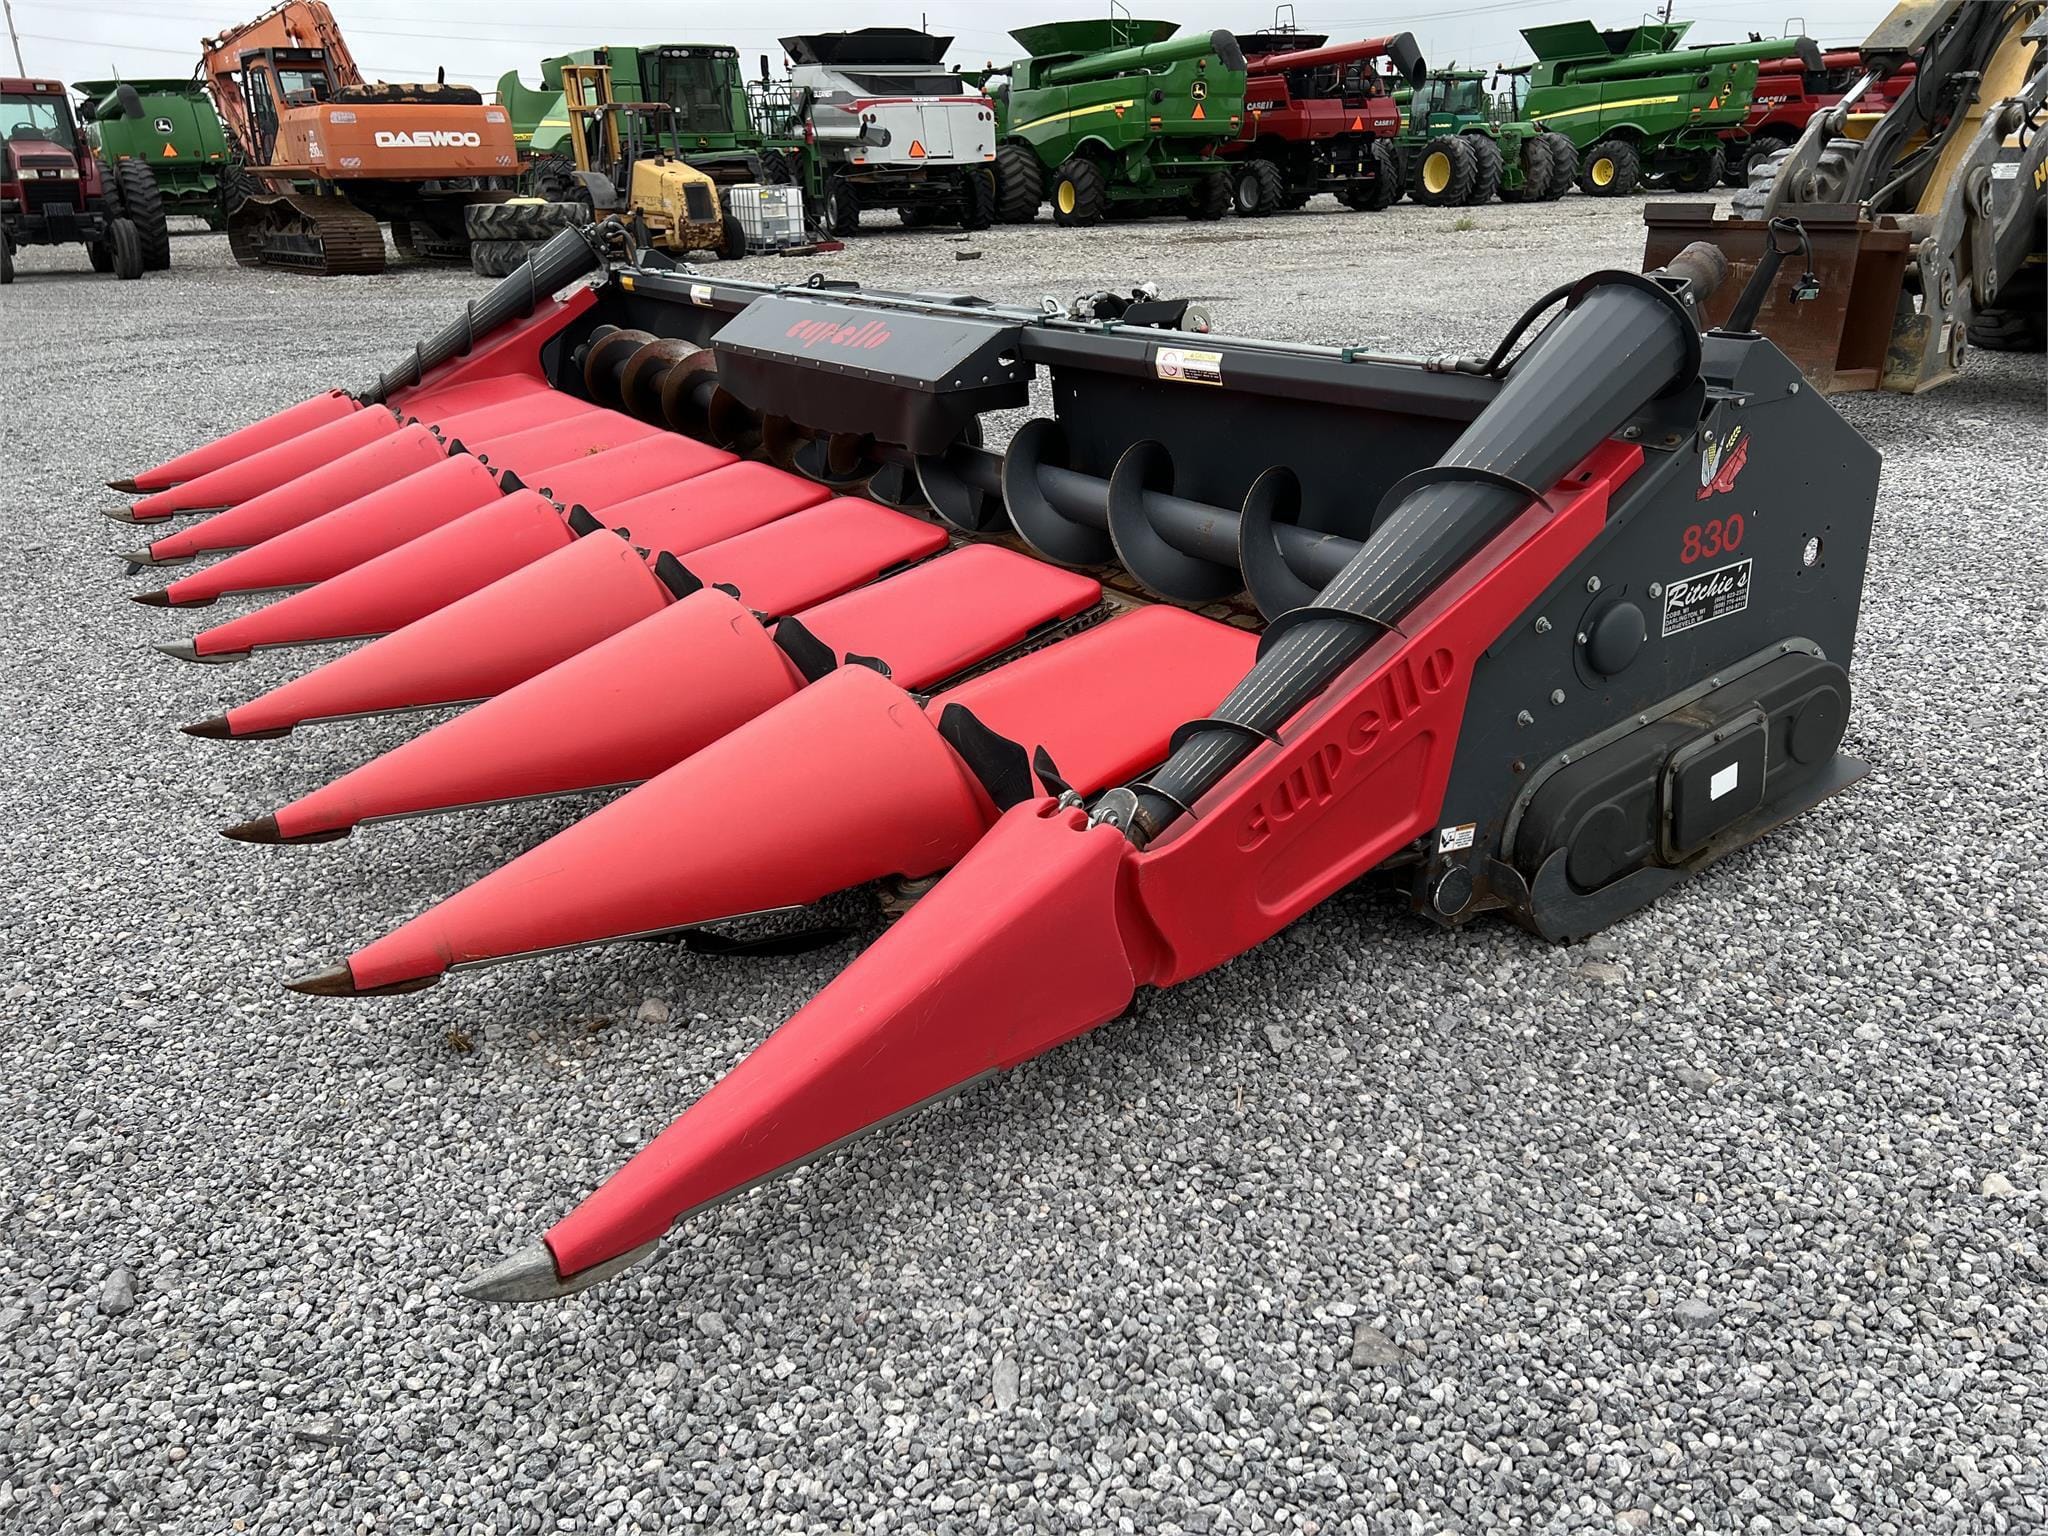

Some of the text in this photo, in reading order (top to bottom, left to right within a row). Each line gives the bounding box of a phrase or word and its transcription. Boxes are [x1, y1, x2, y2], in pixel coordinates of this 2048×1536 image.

[374, 131, 481, 147] DAEWOO
[1680, 512, 1745, 564] 830
[1667, 564, 1748, 612] Ritchie's
